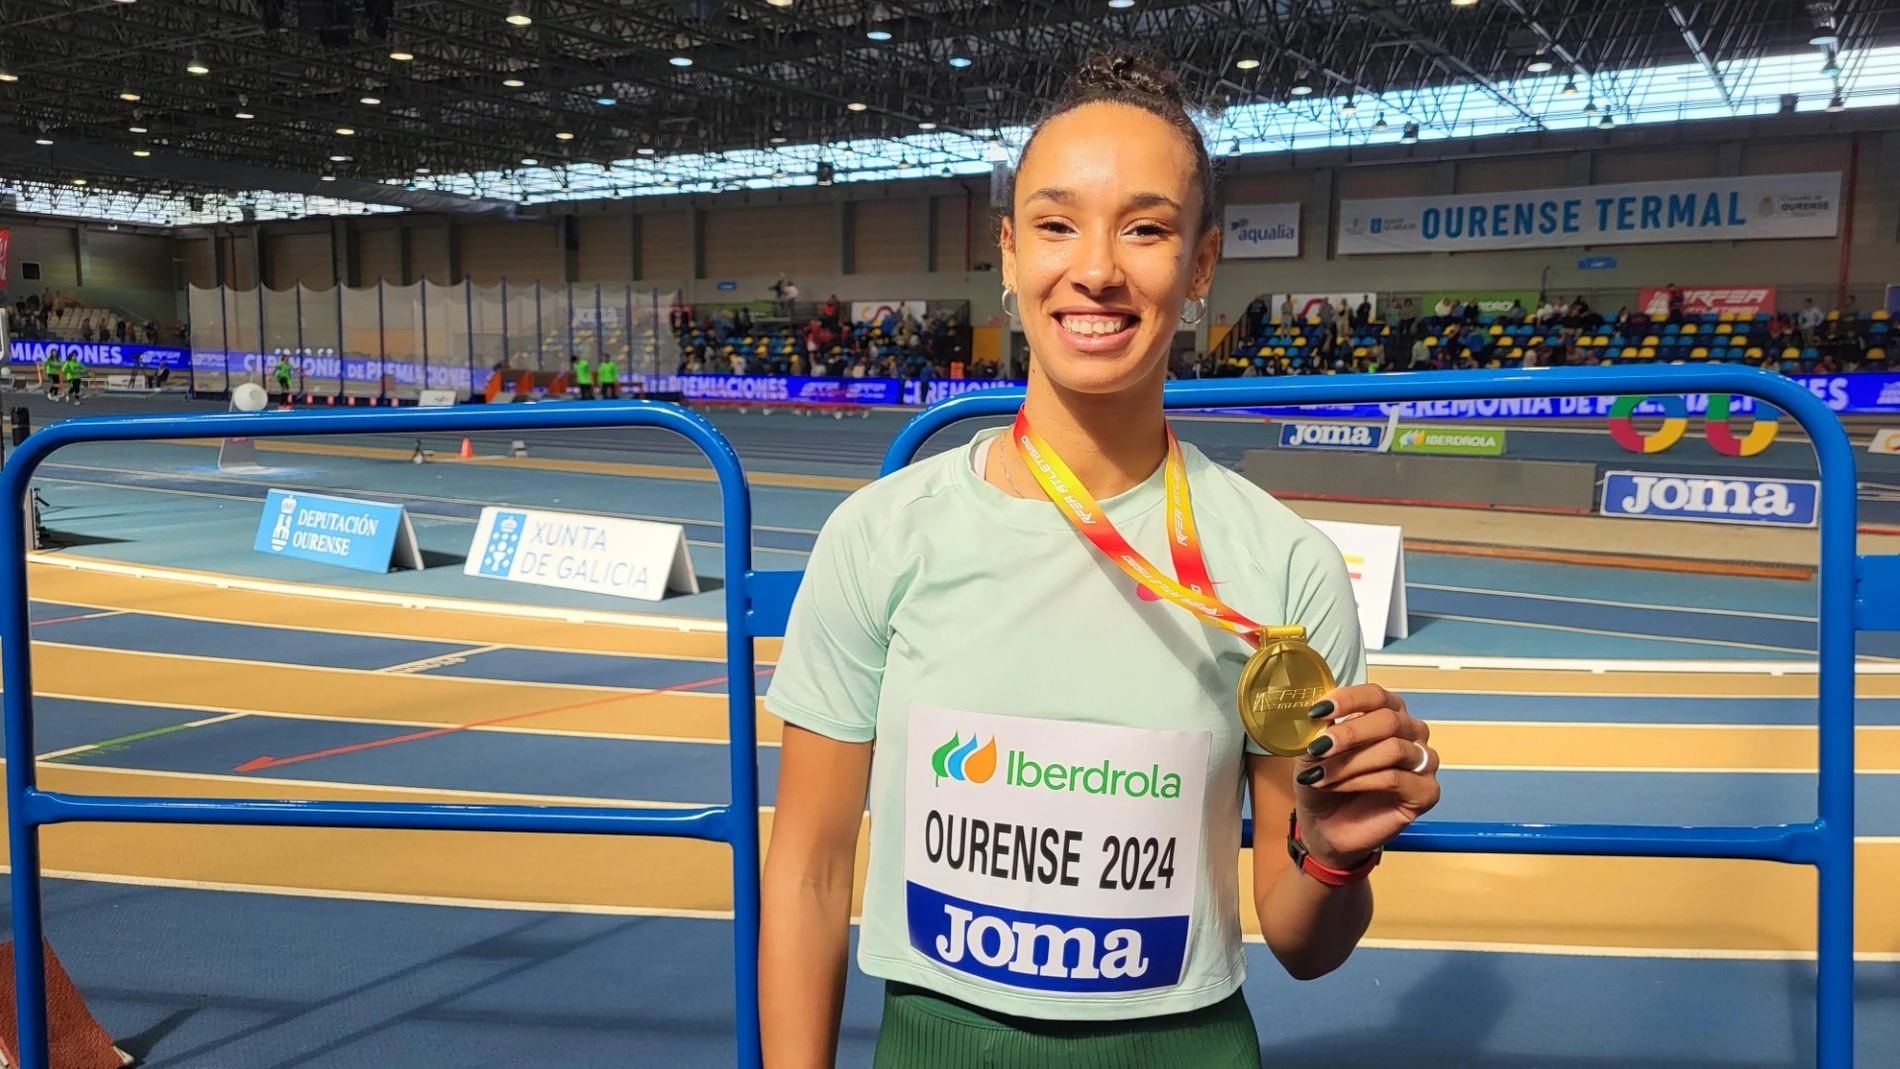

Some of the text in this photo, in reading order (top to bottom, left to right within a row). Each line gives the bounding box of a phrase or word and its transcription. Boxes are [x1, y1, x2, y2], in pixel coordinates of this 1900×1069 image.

[1421, 191, 1746, 240] OURENSE TERMAL
[1238, 223, 1295, 244] aqualia
[1425, 434, 1496, 448] IBERDROLA
[1020, 434, 1069, 493] ATLETISMO
[298, 508, 379, 537] DEPUTACIÓN
[530, 521, 607, 551] XUNTA
[292, 530, 351, 556] OURENSE
[520, 551, 649, 589] DE GALICIA
[1006, 749, 1182, 799] Iberdrola
[925, 809, 1177, 891] OURENSE 2024
